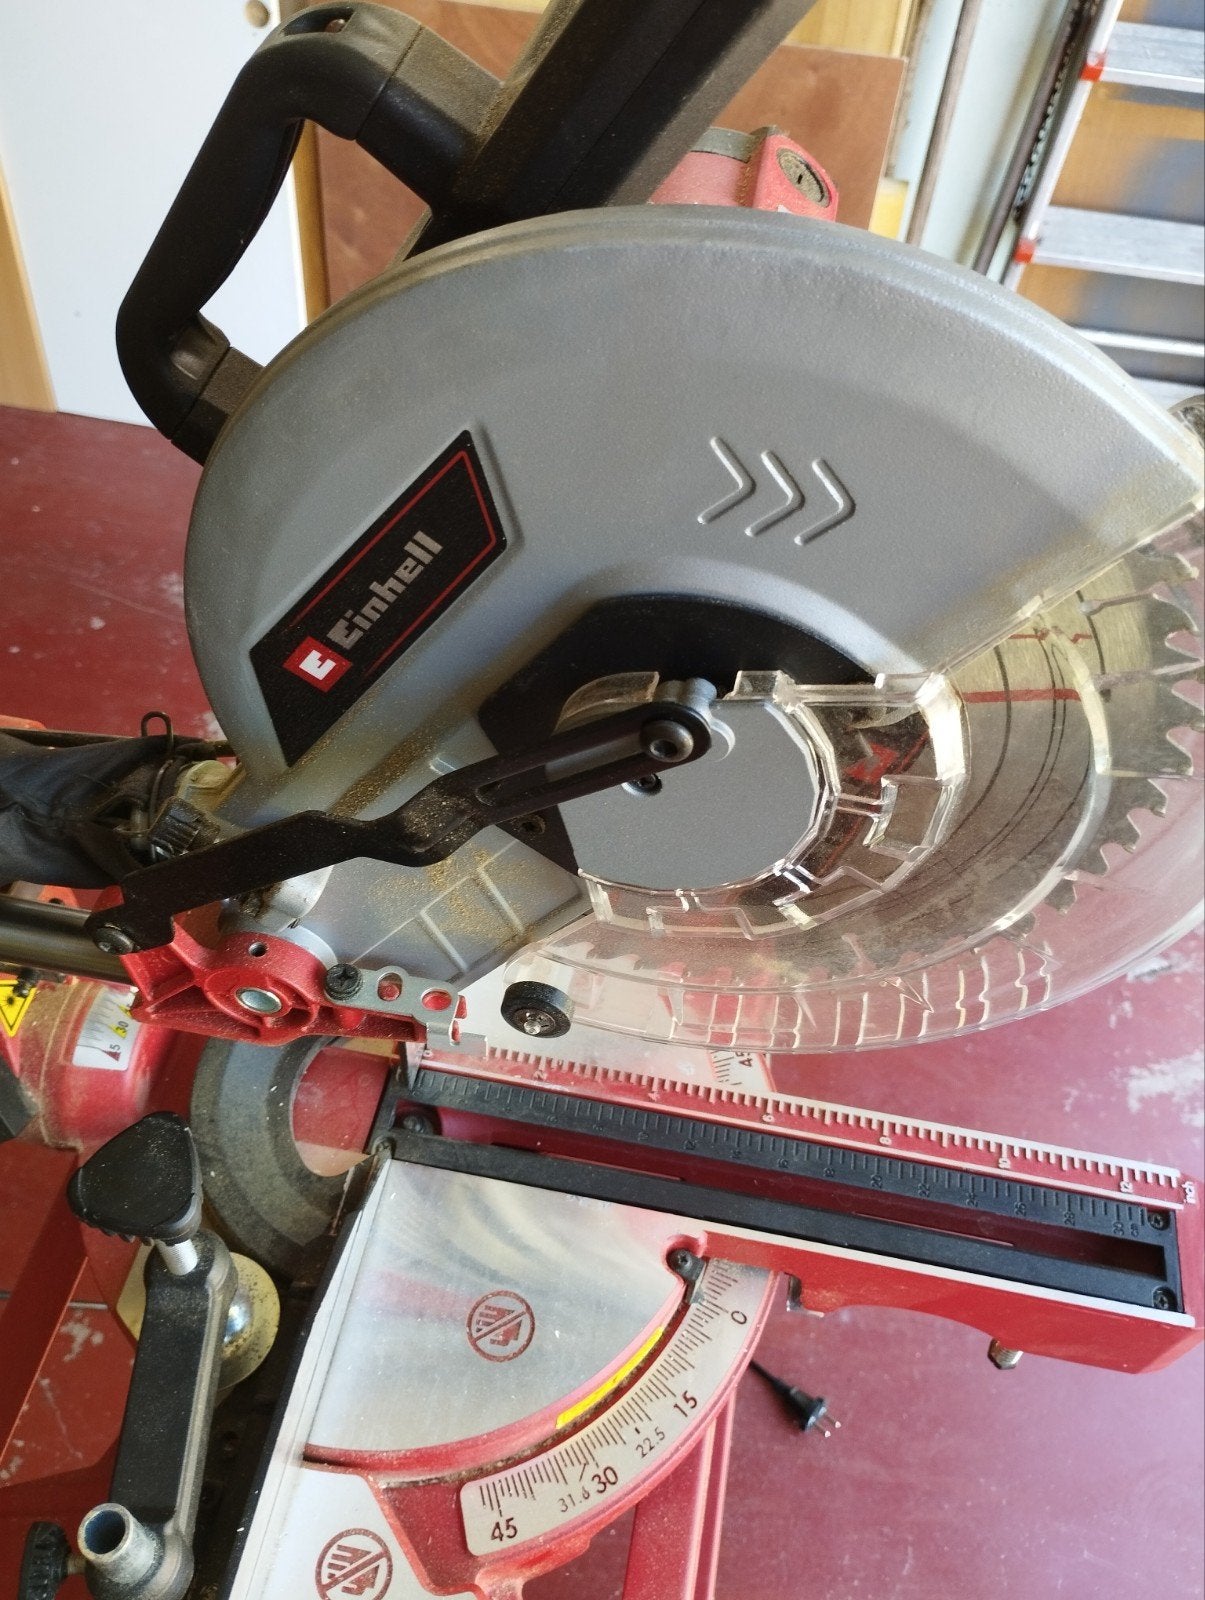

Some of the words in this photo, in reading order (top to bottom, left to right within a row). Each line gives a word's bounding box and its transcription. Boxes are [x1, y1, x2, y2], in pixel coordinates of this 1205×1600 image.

[326, 530, 444, 650] Einhell
[761, 1112, 775, 1124] 6
[878, 1136, 892, 1147] 8
[1119, 1181, 1134, 1194] 12
[870, 1173, 884, 1189] 20
[917, 1181, 931, 1198] 22
[1013, 1201, 1028, 1217] 26
[1063, 1211, 1076, 1227] 28
[1112, 1221, 1126, 1236] 30
[731, 1310, 748, 1326] 0
[673, 1391, 699, 1418] 15
[635, 1427, 667, 1459] 22.5
[590, 1466, 620, 1495] 30
[490, 1517, 519, 1543] 45
